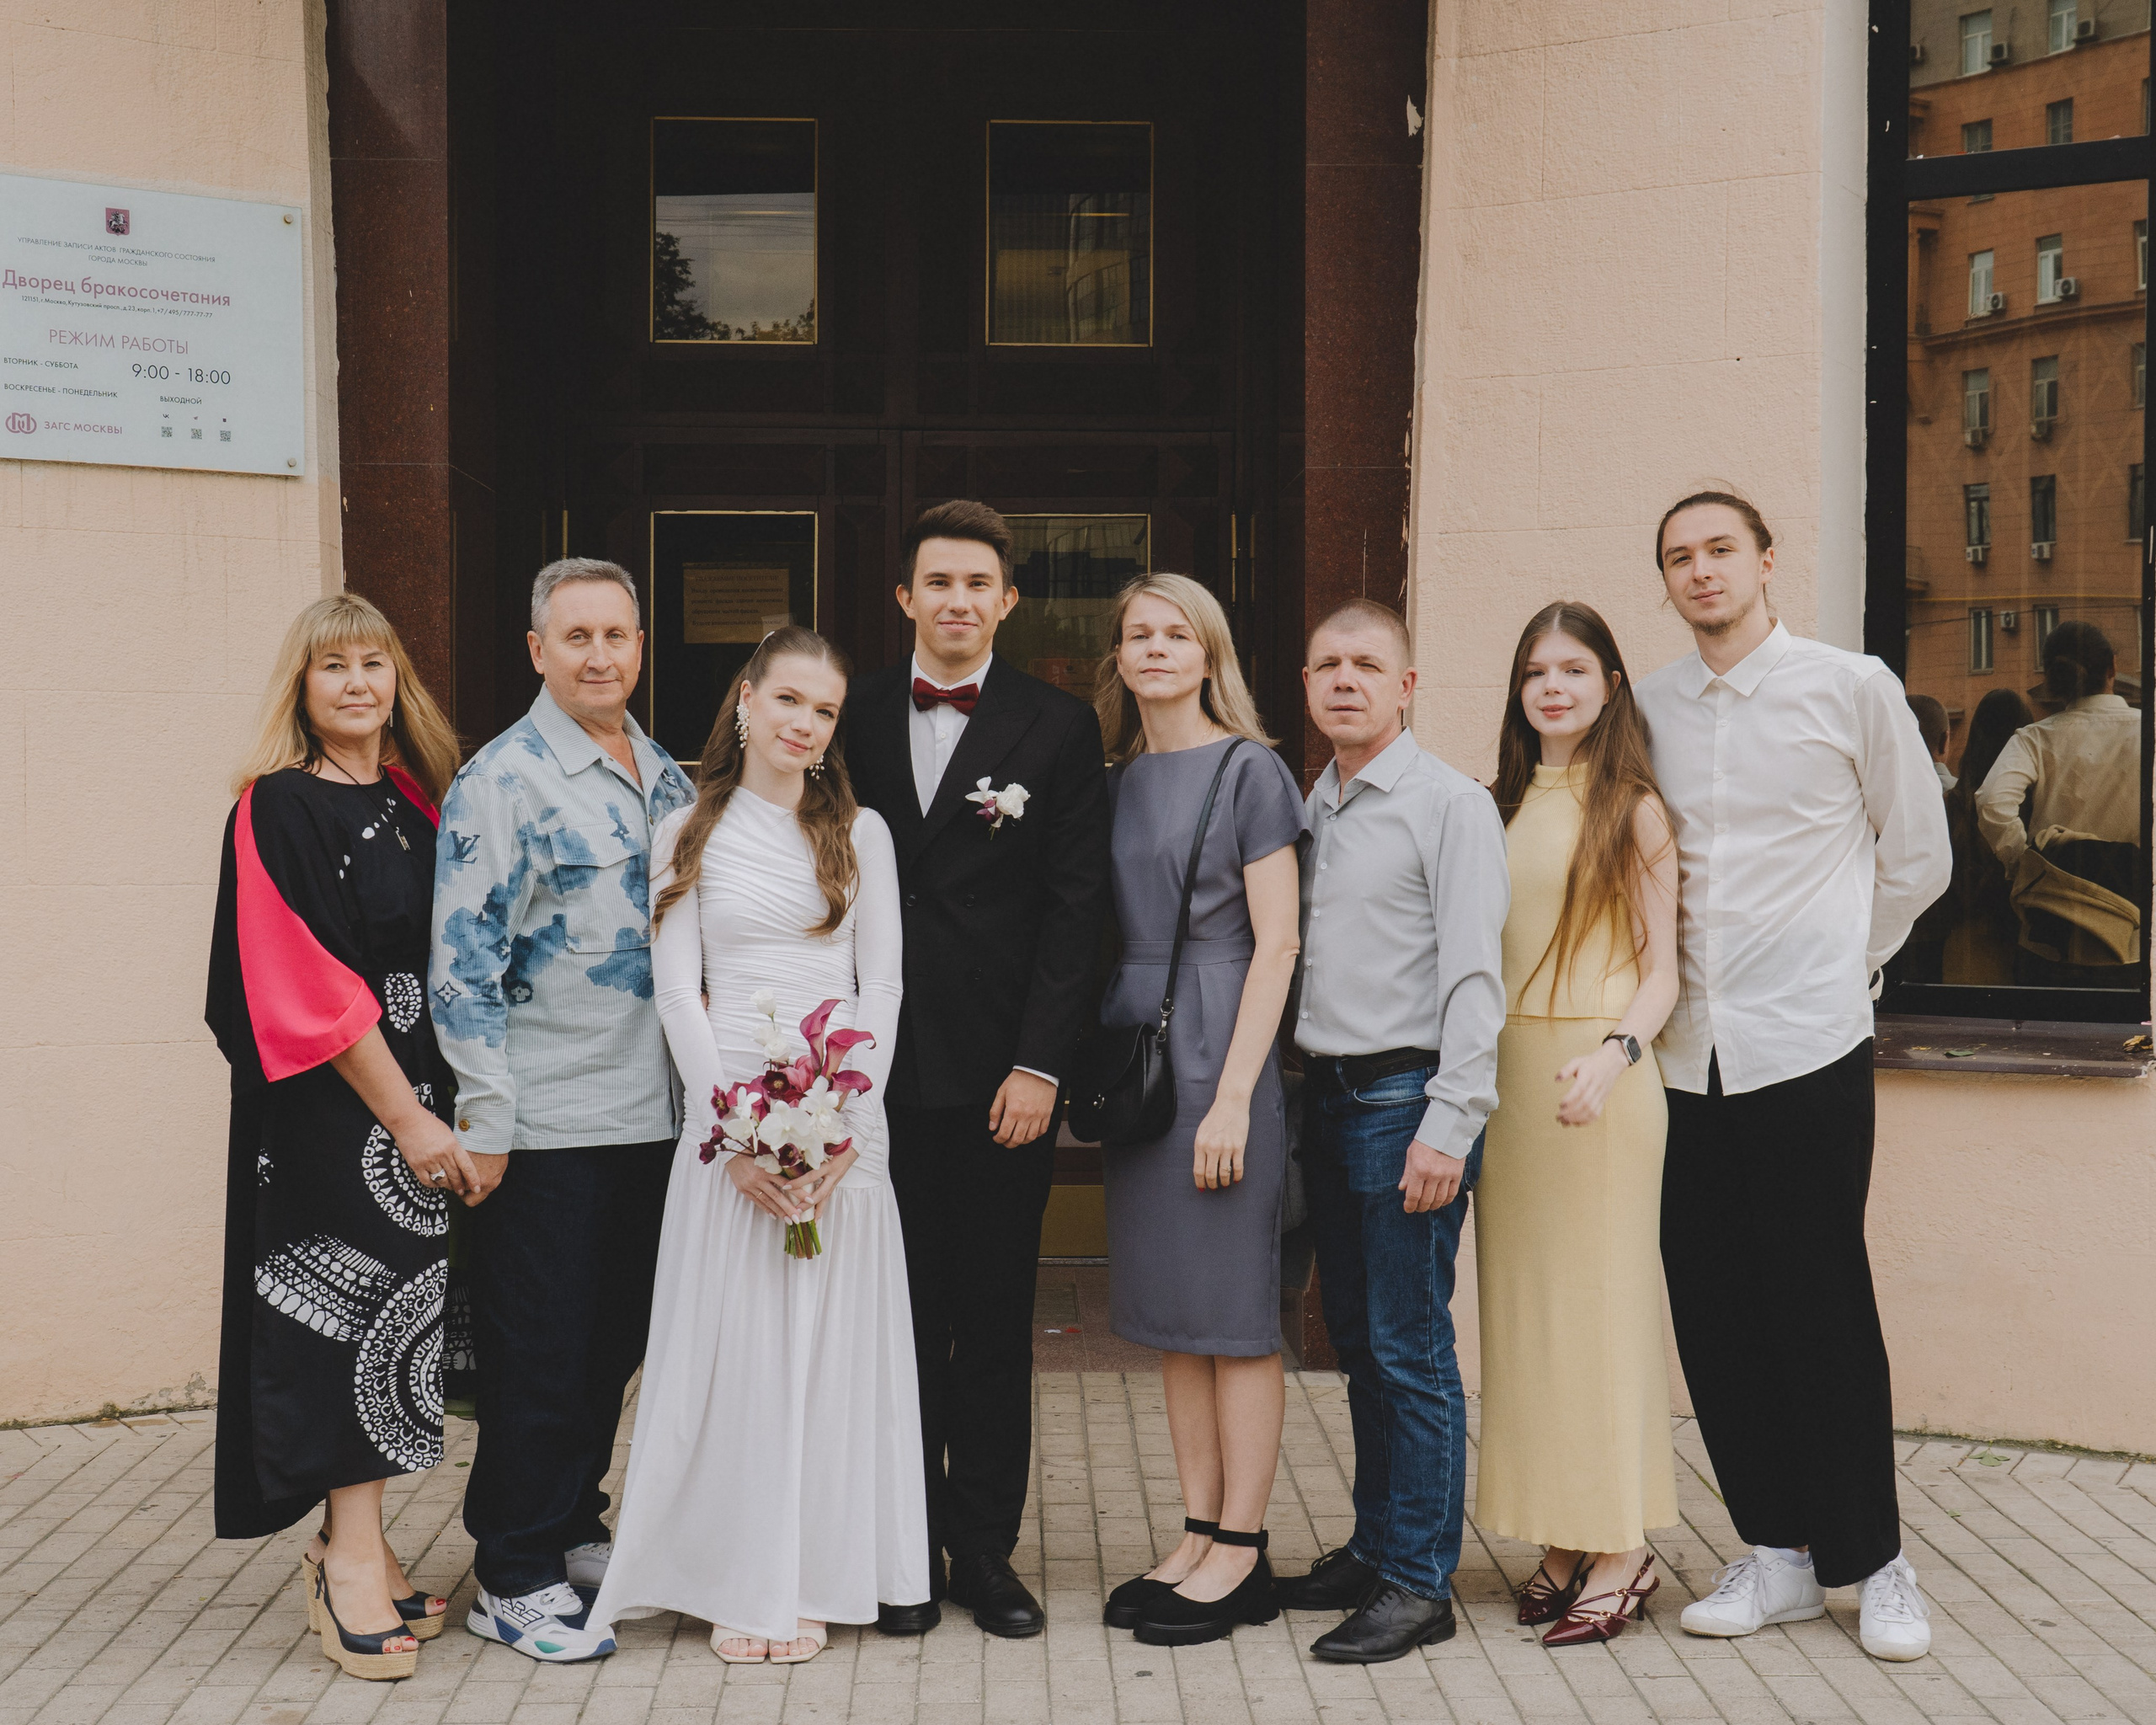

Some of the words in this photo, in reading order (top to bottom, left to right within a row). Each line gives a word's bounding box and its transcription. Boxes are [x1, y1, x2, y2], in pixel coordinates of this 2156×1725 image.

[17, 237, 62, 248] УПРАВЛЕНИЕ
[63, 241, 93, 250] ЗАПИСИ
[119, 247, 173, 259] ГРАЖДАНСКОГО
[174, 253, 216, 263] СОСТОЯНИЯ
[88, 254, 116, 264] ГОРОДА
[117, 258, 148, 267] МОСКВЫ
[3, 269, 76, 294] Дворец
[81, 276, 231, 307] бракосочетания
[67, 300, 103, 308] Кутузовский
[49, 328, 115, 349] РЕЖИМ
[121, 334, 189, 355] РАБОТЫ
[3, 357, 39, 367] ВТОРНИК
[45, 360, 79, 370] СУББОТА
[131, 363, 169, 381] 9:00
[187, 367, 232, 385] 18:00
[3, 382, 56, 393] ВОСКРЕСЕНЬЕ
[62, 387, 118, 398] ПОНЕДЕЛЬНИК
[159, 395, 202, 405] ВЫХОДНОЙ
[44, 421, 71, 430] ЗАГС
[73, 423, 123, 435] МОСКВЫ
